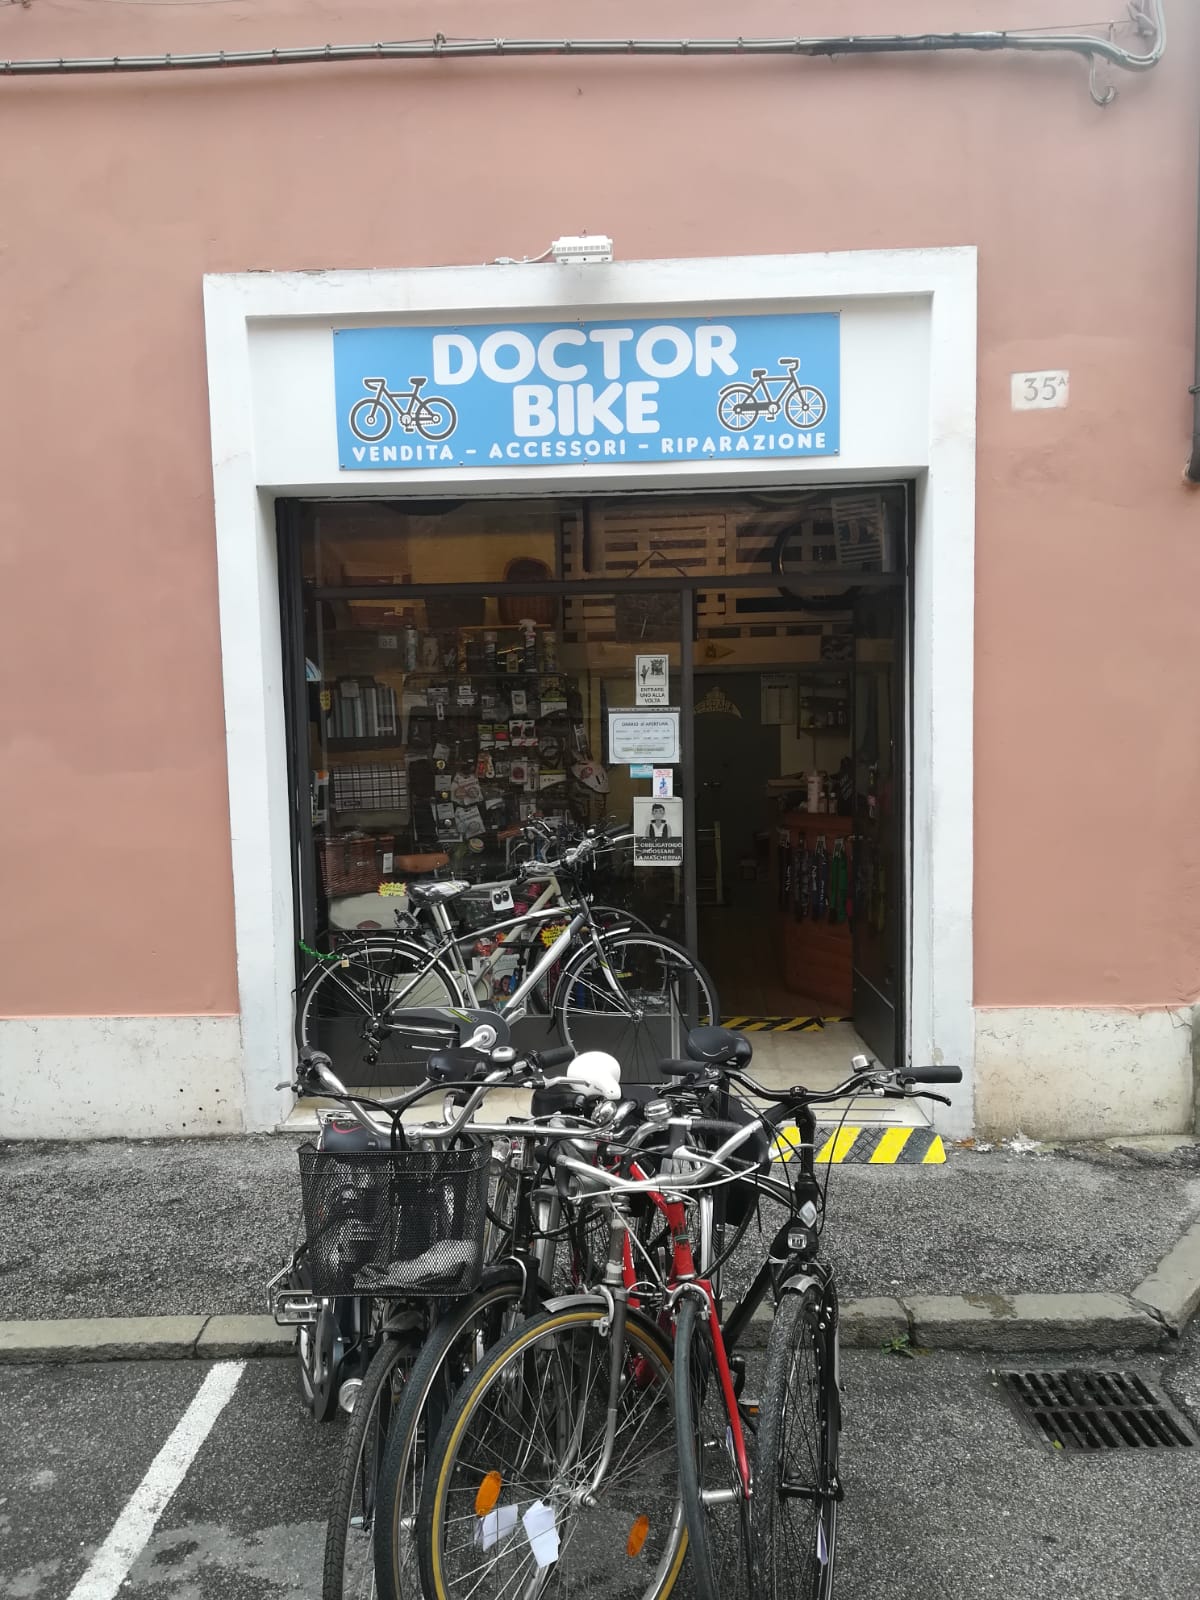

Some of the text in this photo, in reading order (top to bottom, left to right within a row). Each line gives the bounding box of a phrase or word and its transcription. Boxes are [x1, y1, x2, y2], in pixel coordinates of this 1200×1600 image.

[432, 325, 739, 386] DOCTOR
[512, 381, 661, 438] BIKE
[352, 445, 454, 463] VENDITA
[488, 439, 626, 460] ACCESSORI
[661, 431, 826, 454] RIPARAZIONE
